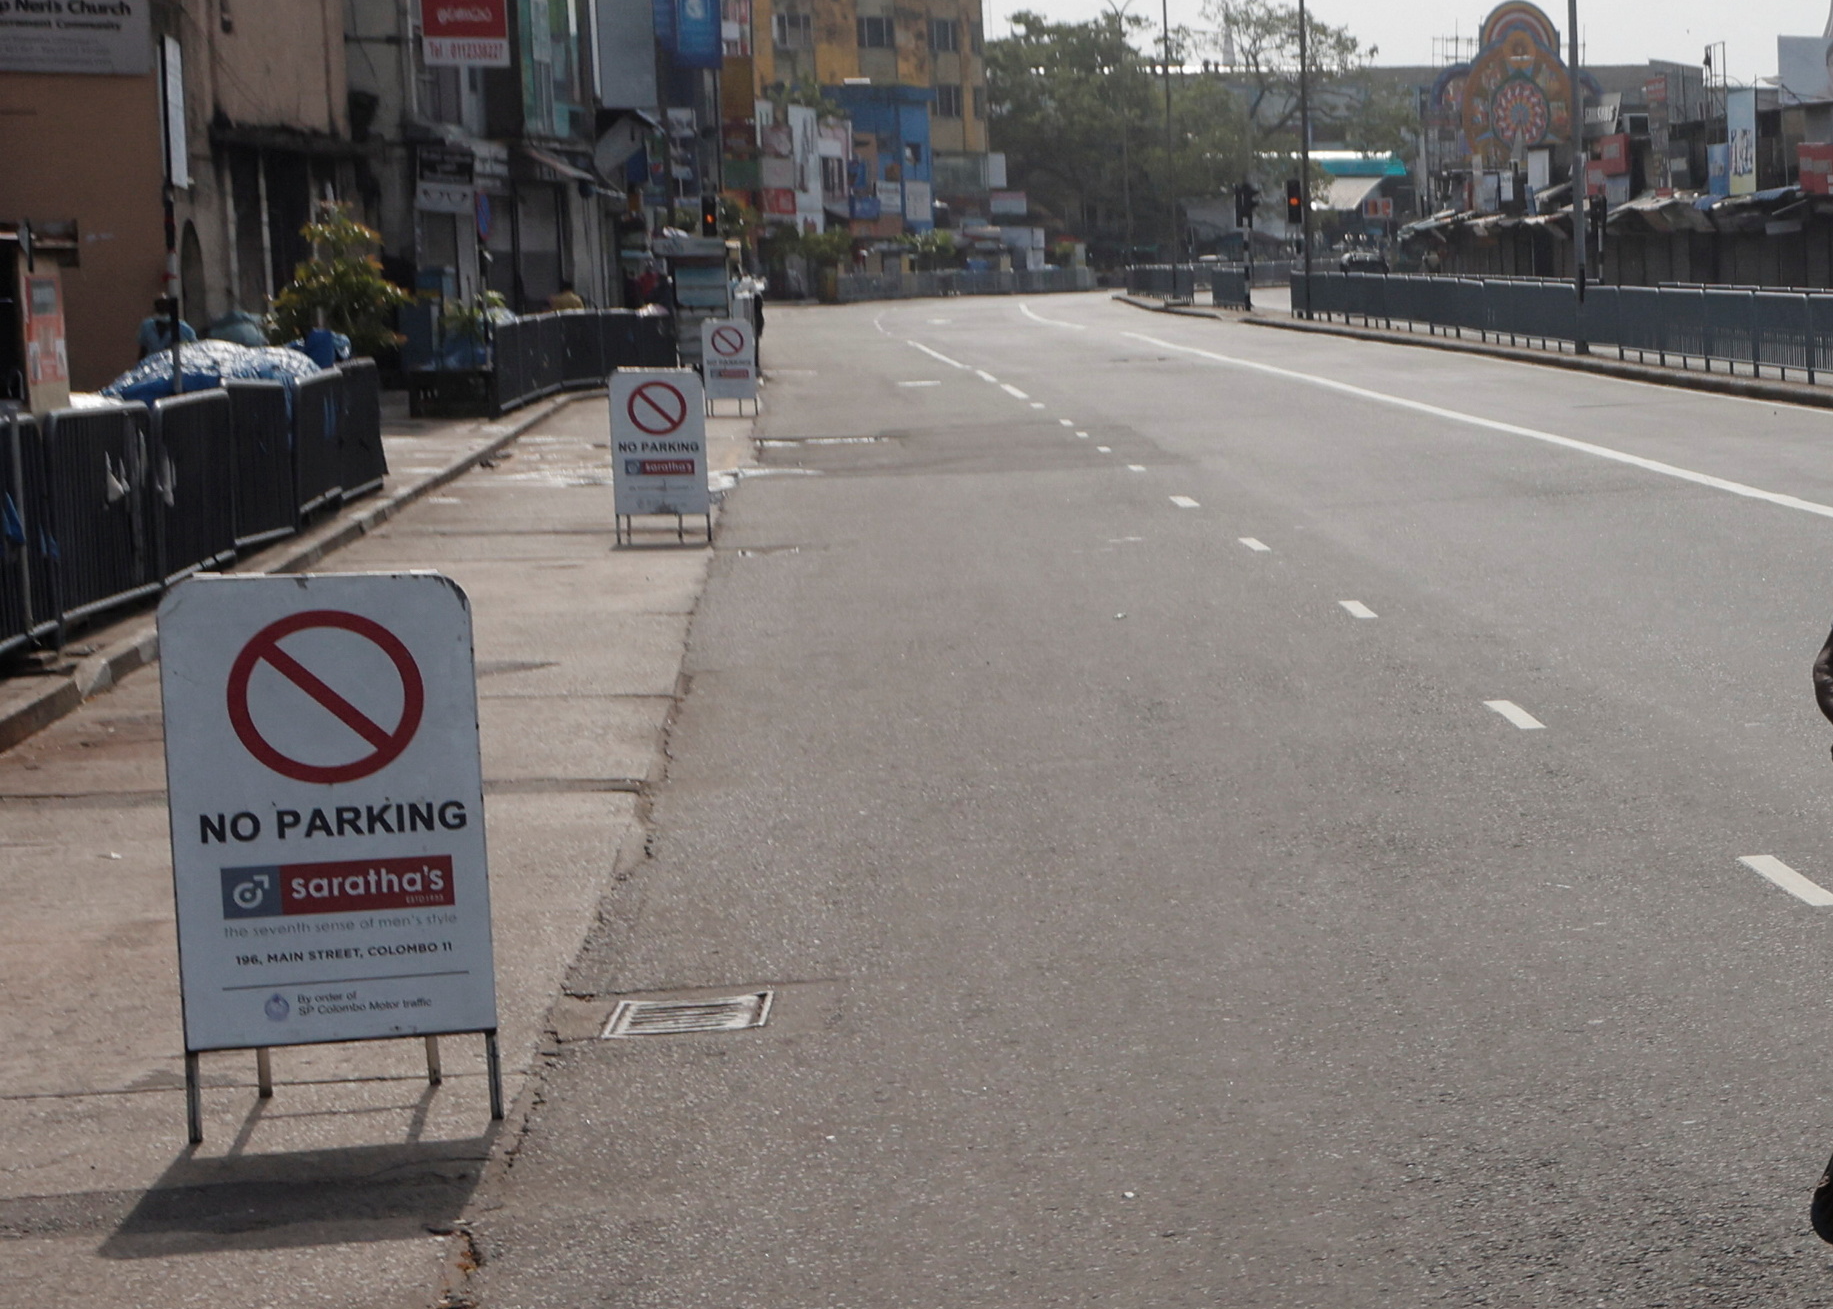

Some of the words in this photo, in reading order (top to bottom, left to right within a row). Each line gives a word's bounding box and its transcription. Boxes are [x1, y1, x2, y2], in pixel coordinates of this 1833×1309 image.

[67, 0, 131, 16] Church
[618, 442, 637, 454] NO
[641, 442, 699, 454] PARKING
[200, 811, 261, 844] NO
[277, 800, 467, 840] PARKING
[291, 865, 444, 900] saratha's
[224, 926, 248, 939] the
[253, 922, 311, 937] seventh
[315, 921, 355, 933] sense
[360, 916, 375, 929] of
[379, 914, 423, 928] men's
[426, 912, 458, 927] style
[235, 954, 263, 967] 196,
[267, 952, 304, 964] MAIN
[308, 947, 364, 961] STREET,
[368, 943, 438, 957] COLOMBO
[443, 941, 453, 952] 11
[297, 993, 311, 1006] By
[314, 991, 343, 1003] order
[346, 990, 358, 1001] of
[298, 1006, 315, 1017] SP
[317, 1003, 367, 1016] Colombo
[369, 999, 400, 1012] Motor
[402, 996, 432, 1009] traffic
